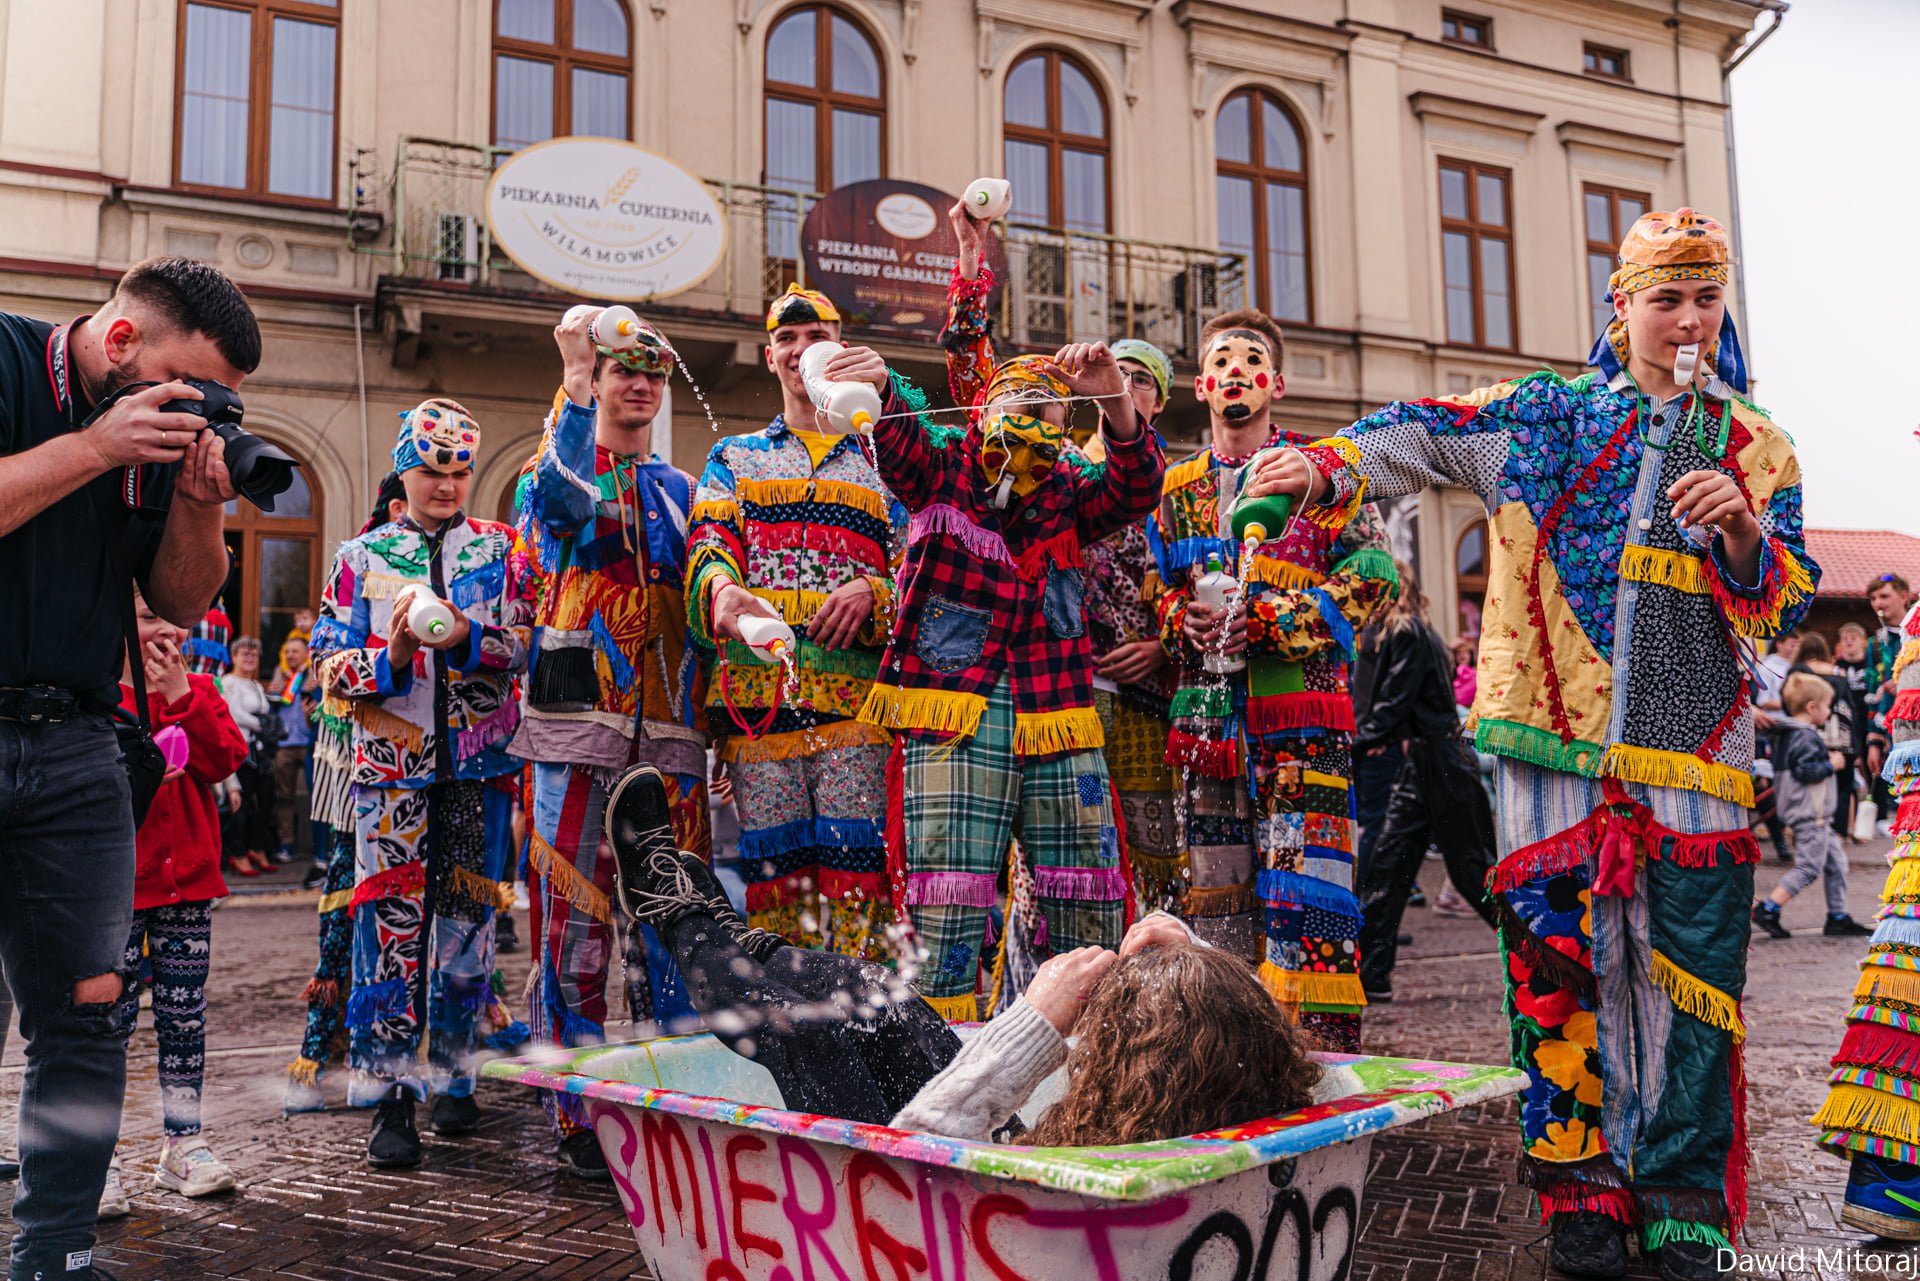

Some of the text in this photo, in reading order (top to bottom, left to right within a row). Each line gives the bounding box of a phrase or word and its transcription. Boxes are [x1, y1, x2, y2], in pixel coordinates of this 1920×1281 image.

[501, 185, 600, 211] PIEKARNIA
[619, 201, 713, 226] CUKIERNIA
[542, 220, 678, 264] WILAMOWICE
[817, 239, 957, 269] PIEKARNIA CUKIE
[818, 256, 881, 278] WYROBY
